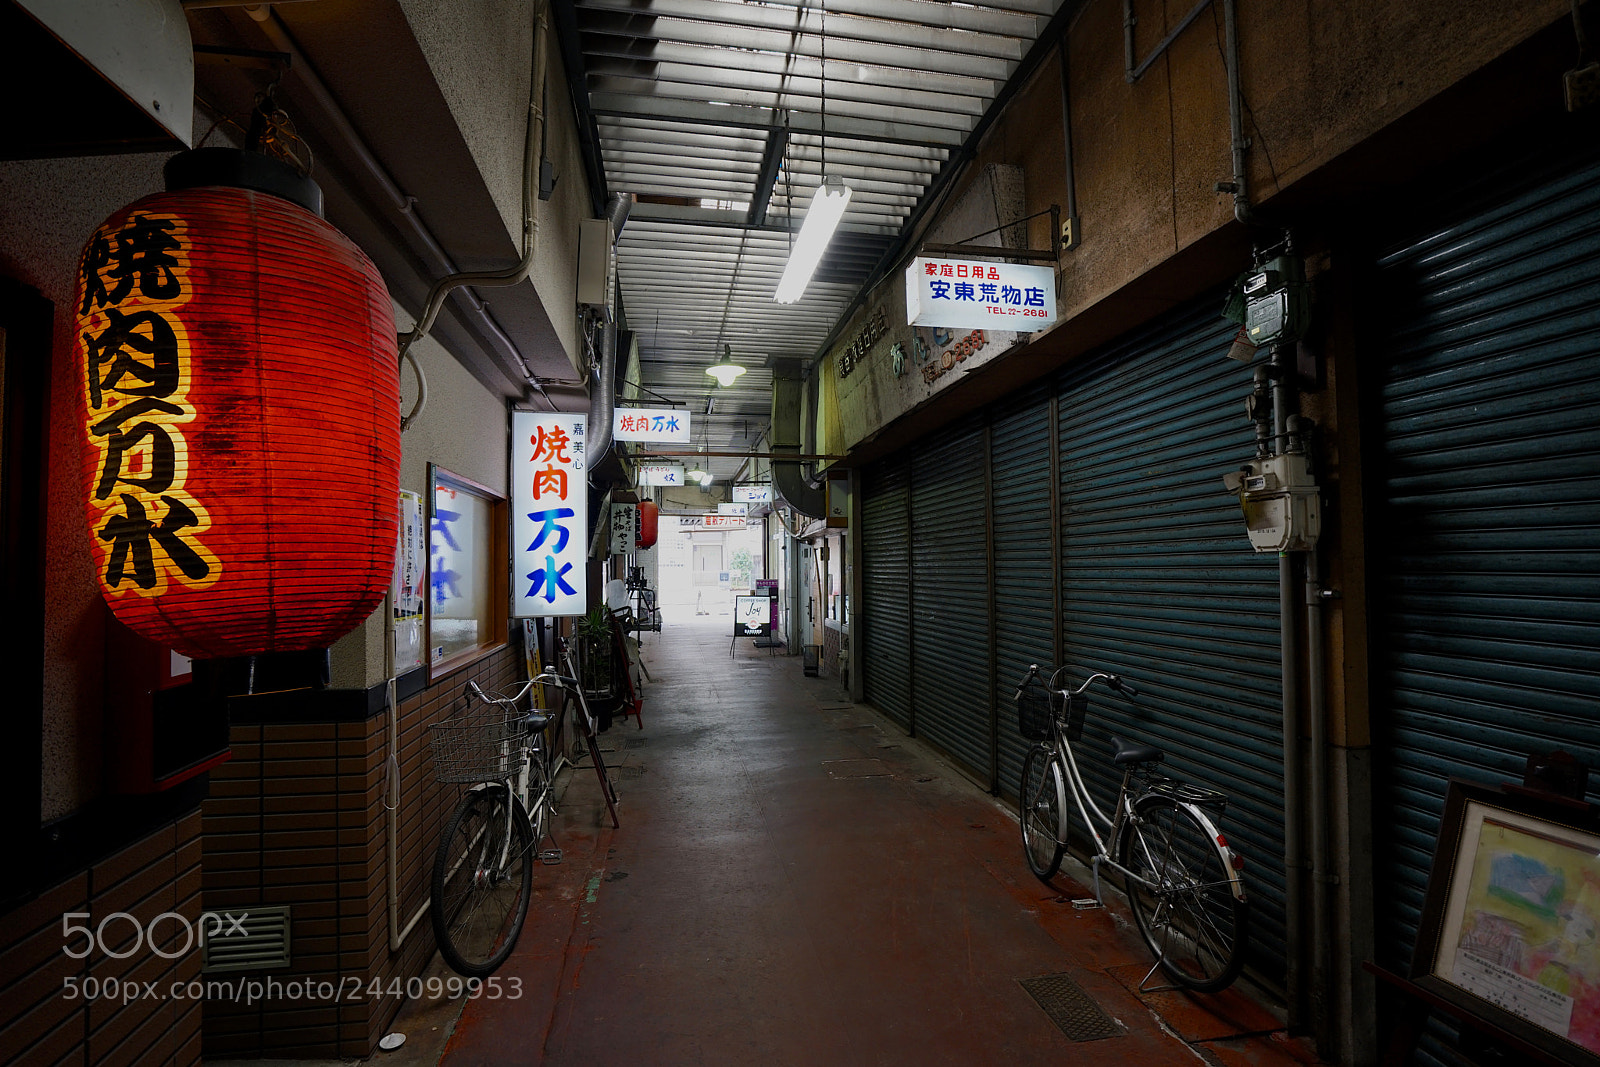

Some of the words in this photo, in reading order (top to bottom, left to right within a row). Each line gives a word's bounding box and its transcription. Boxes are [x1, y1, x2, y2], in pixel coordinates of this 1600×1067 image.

[925, 262, 1000, 280] 家庭日用品
[929, 279, 1045, 307] 安東荒物店
[986, 306, 1007, 315] TEL
[79, 214, 212, 591] 焼肉万水
[620, 415, 680, 433] 焼肉万水
[572, 423, 584, 470] 嘉美心
[525, 424, 578, 604] 焼肉万水
[617, 532, 628, 553] やっこ
